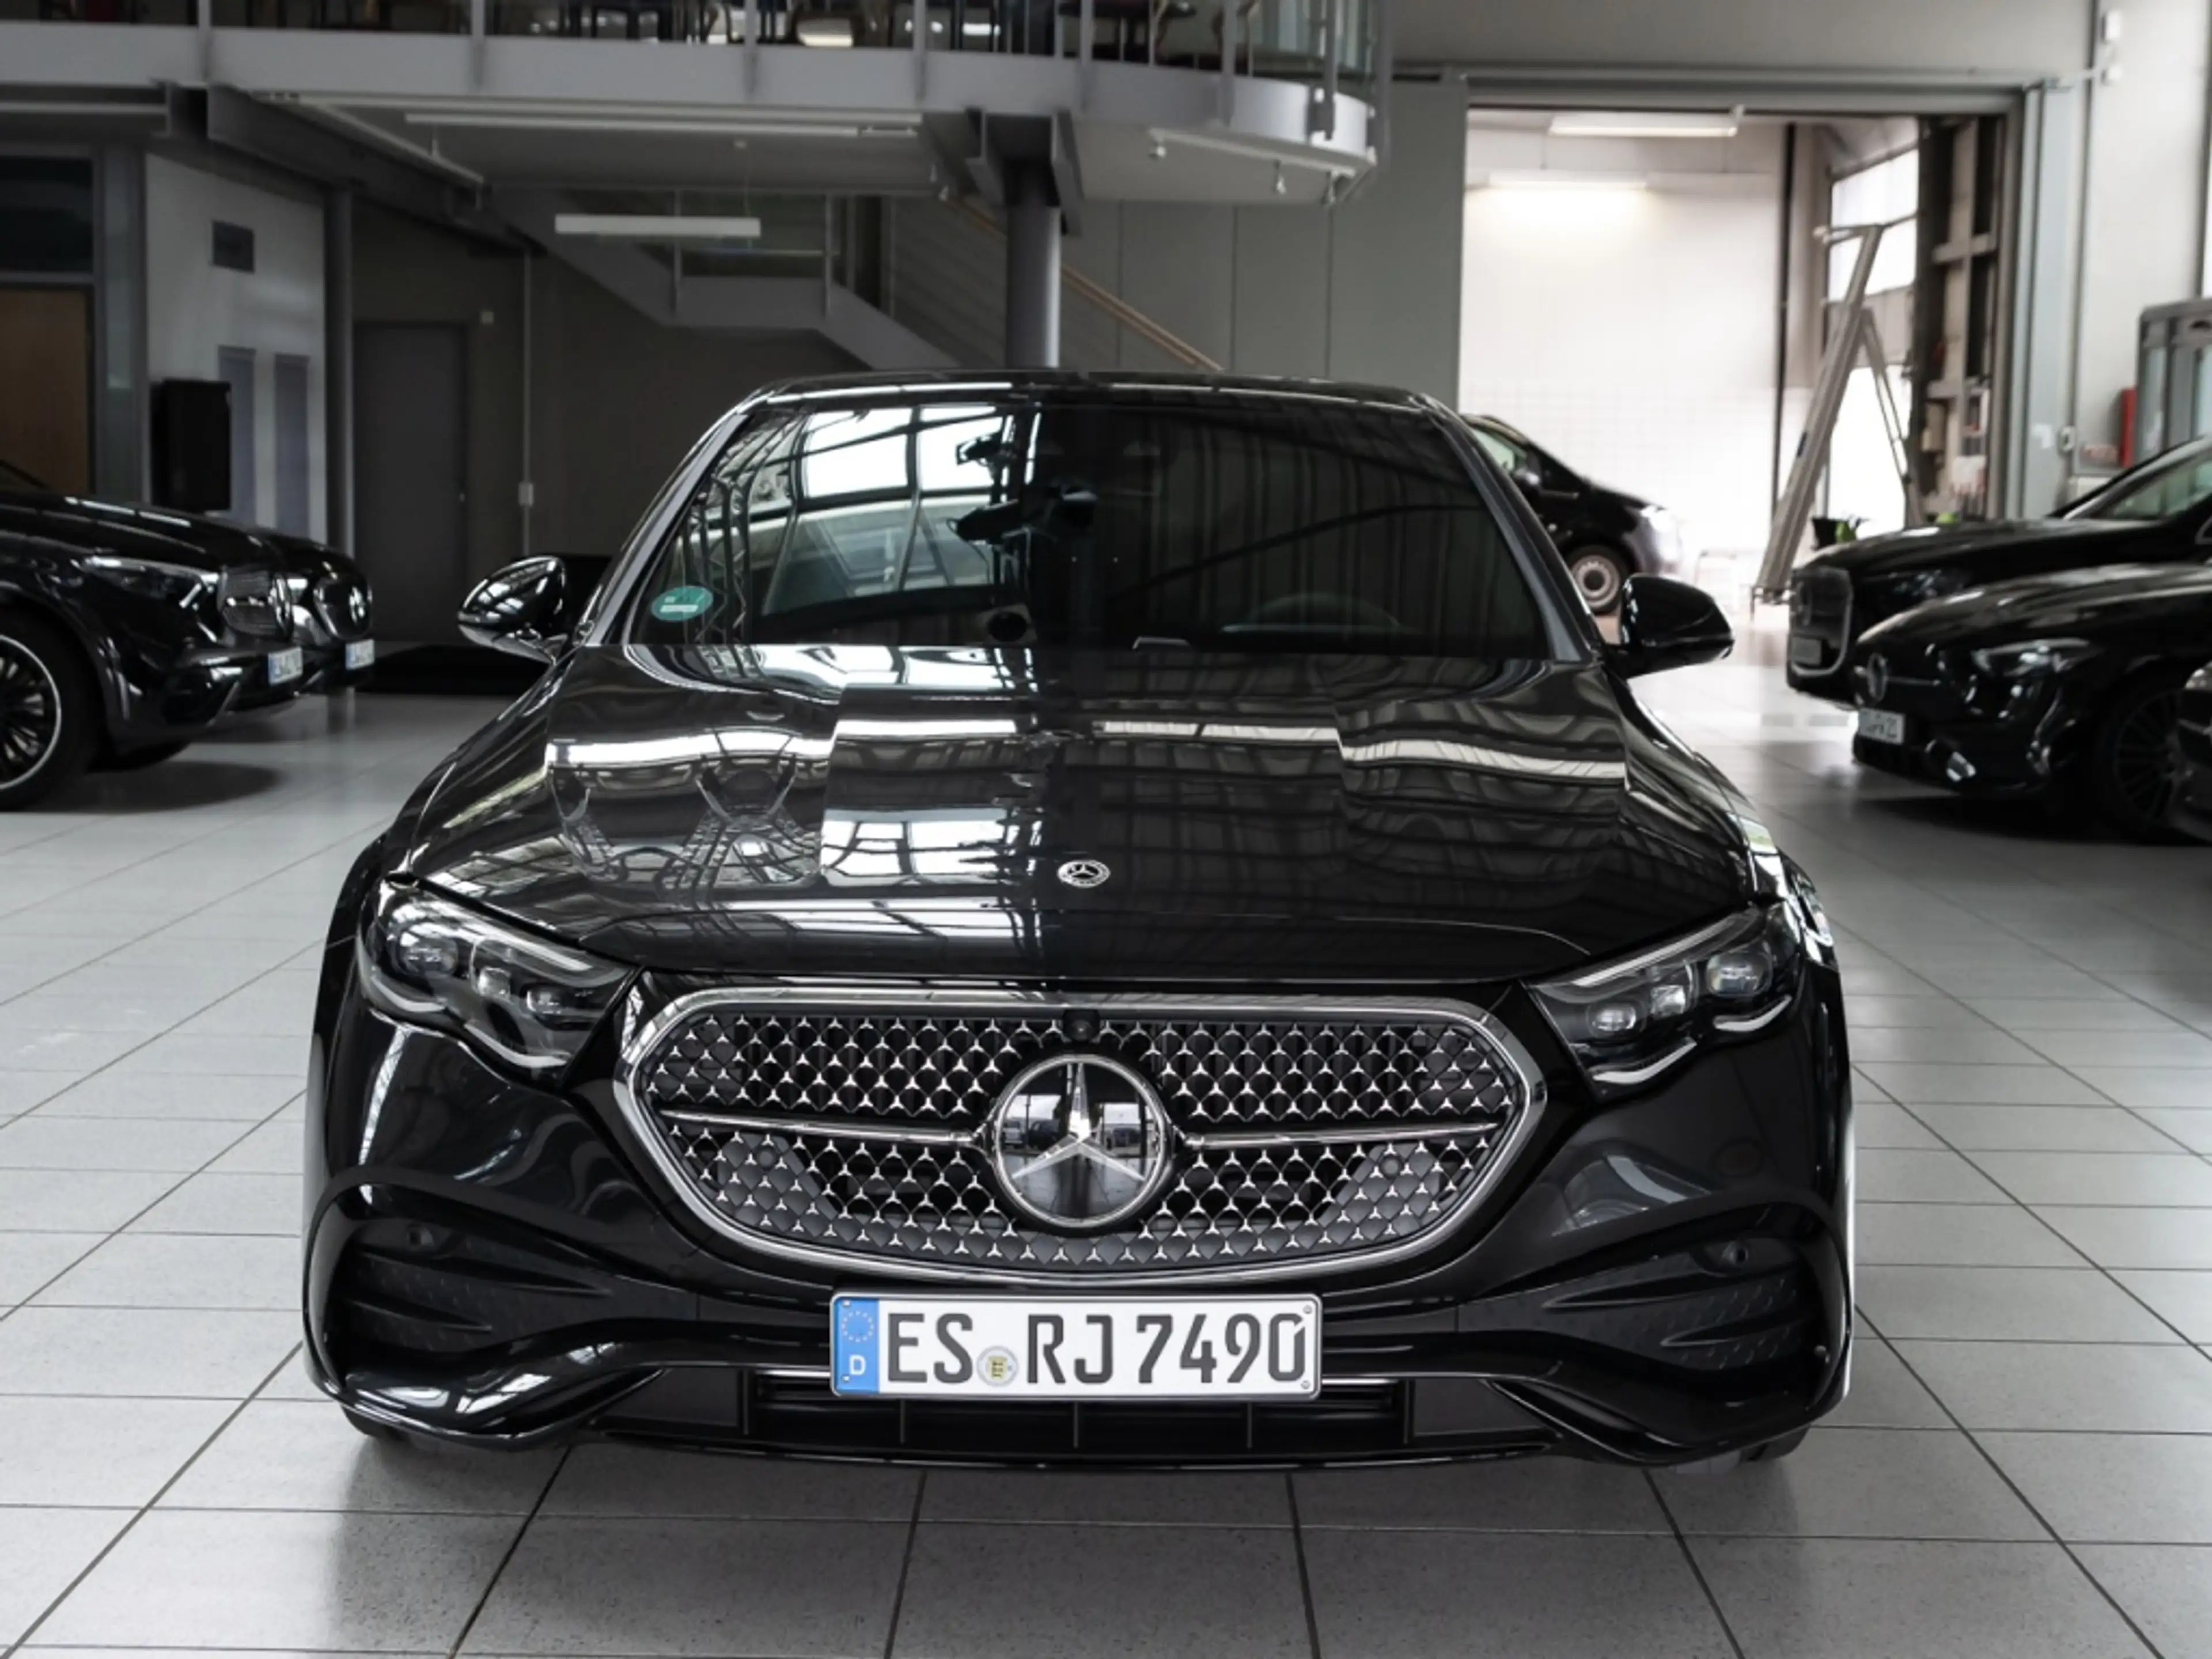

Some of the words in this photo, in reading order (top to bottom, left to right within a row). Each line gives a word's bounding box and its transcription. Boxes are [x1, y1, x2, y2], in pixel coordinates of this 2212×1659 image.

[849, 1355, 866, 1375] D
[888, 1313, 972, 1384] ES
[1027, 1314, 1113, 1384] RJ
[1137, 1313, 1305, 1384] 7490
